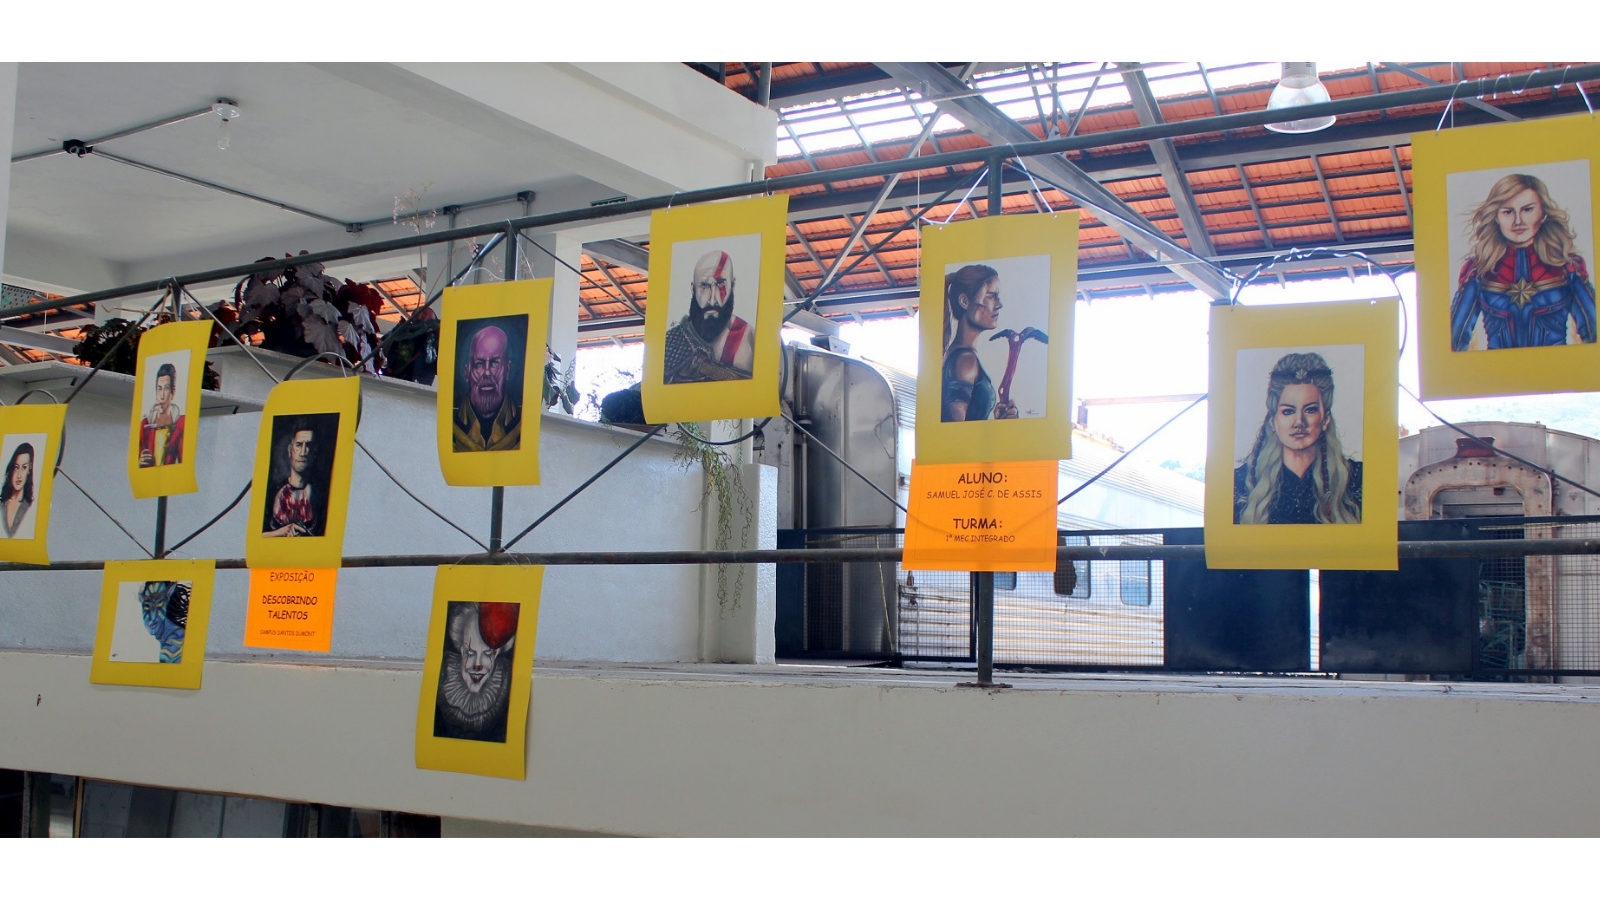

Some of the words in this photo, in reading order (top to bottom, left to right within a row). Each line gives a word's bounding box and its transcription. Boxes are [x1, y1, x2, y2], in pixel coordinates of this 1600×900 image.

[958, 472, 1007, 484] ALUNO:
[927, 490, 960, 499] SAMUEL
[963, 487, 984, 498] JOSÉ
[987, 490, 994, 498] C.
[998, 490, 1009, 498] DE
[1012, 490, 1042, 498] ASSIS
[953, 518, 1003, 529] TURMA:
[270, 570, 314, 583] EXPOSIÇÃO
[262, 595, 317, 605] DESCOBRINDO
[268, 610, 308, 620] TALENTOS
